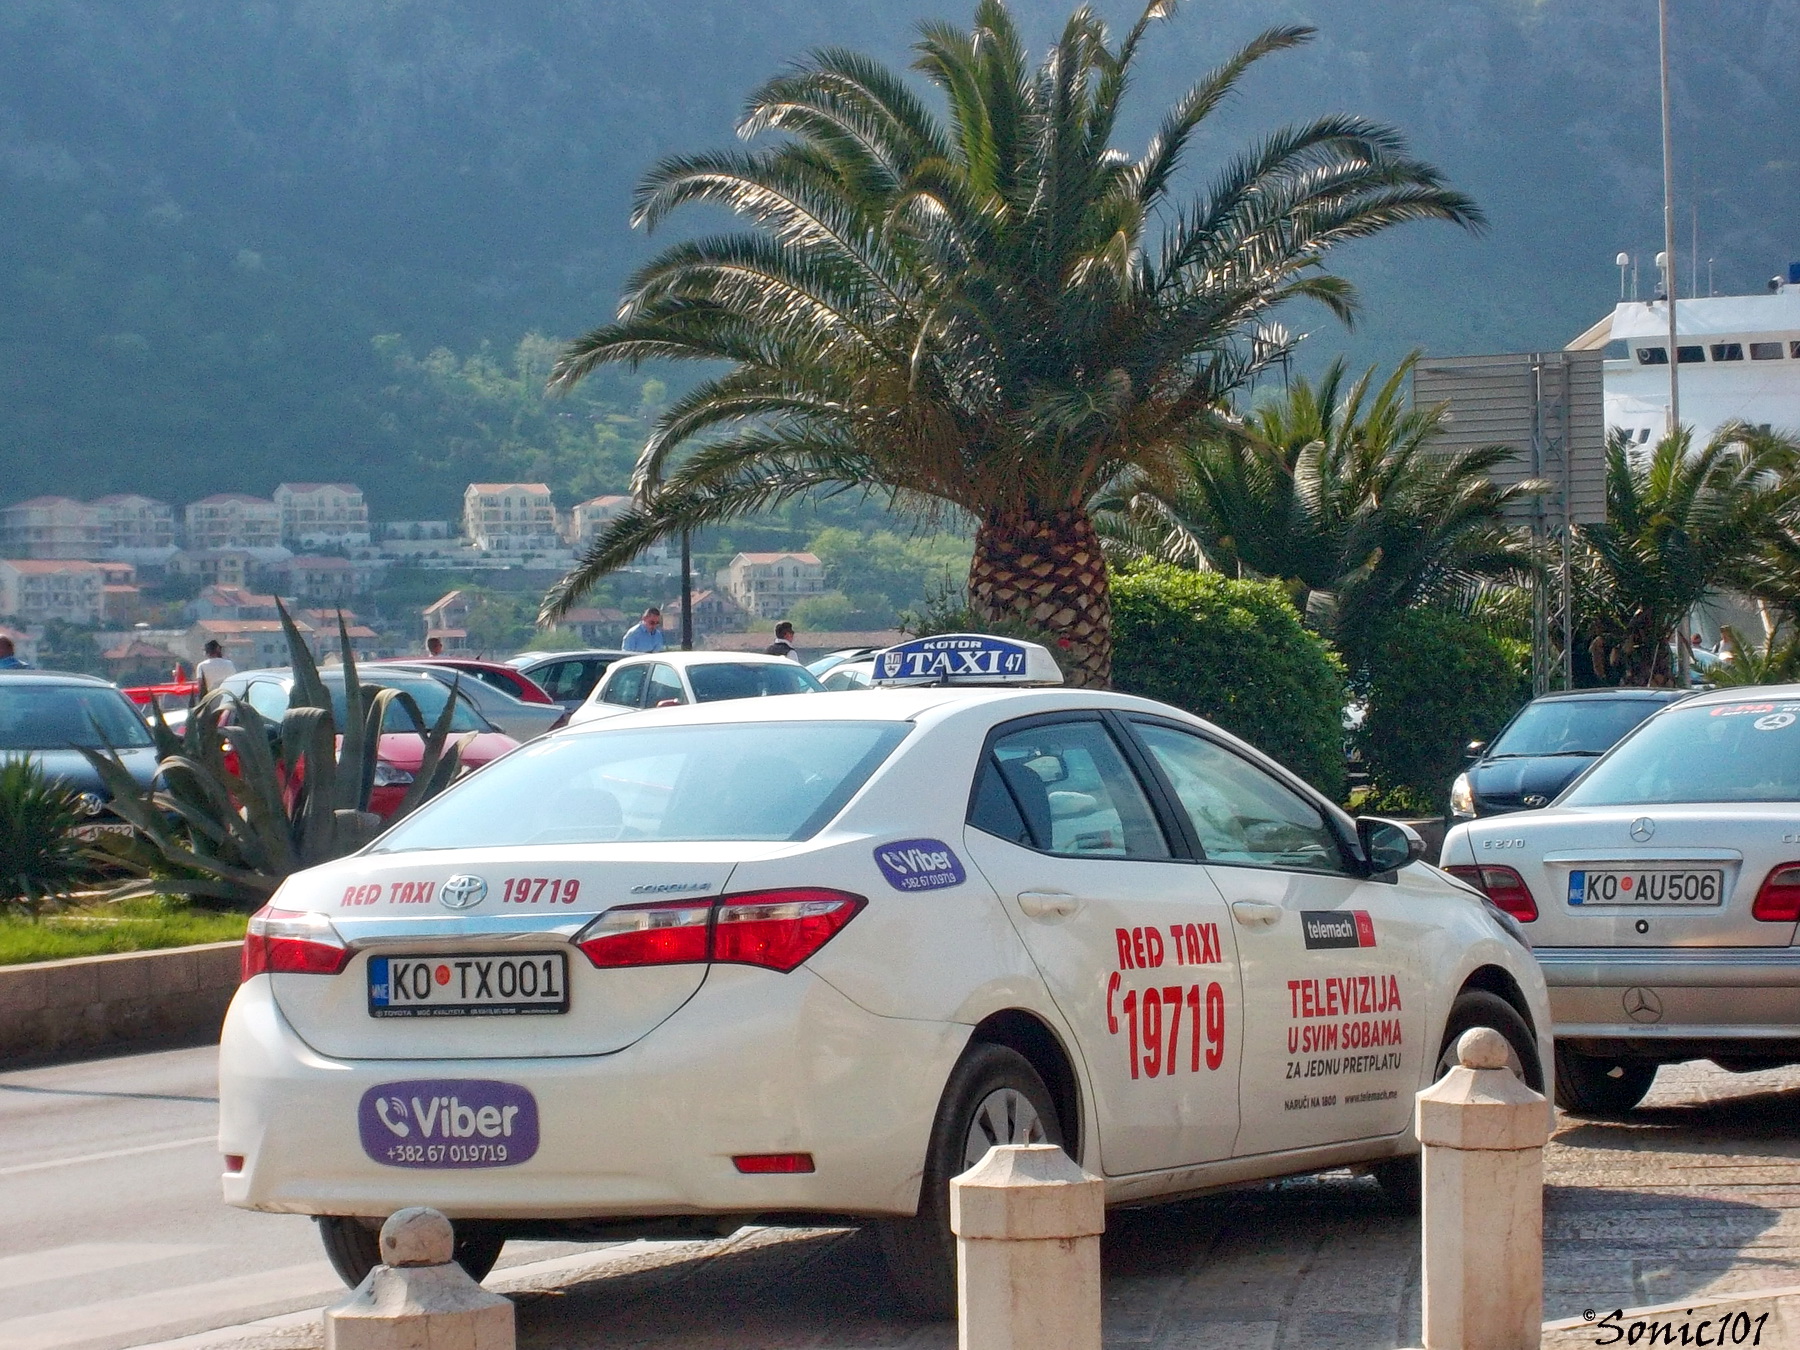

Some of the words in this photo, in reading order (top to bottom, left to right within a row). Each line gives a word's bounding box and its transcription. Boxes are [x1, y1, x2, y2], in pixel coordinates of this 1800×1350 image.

[923, 640, 982, 650] KOTOR
[906, 650, 1003, 675] TAXI
[1004, 654, 1023, 672] 47
[1495, 838, 1526, 849] 270
[898, 848, 952, 873] Viber
[341, 884, 381, 907] RED
[389, 881, 435, 904] TAXI
[502, 877, 580, 904] 19719
[901, 877, 921, 889] +382
[920, 875, 930, 887] 67
[930, 872, 957, 885] 019719
[1586, 874, 1618, 901] KO
[1634, 872, 1716, 900] AU506
[1307, 918, 1353, 939] telemach
[1115, 926, 1165, 970] RED
[1169, 922, 1222, 966] TAXI
[393, 962, 431, 1000] KO
[455, 959, 559, 999] TX001
[1287, 974, 1402, 1018] TELEVIZIJA
[1122, 981, 1225, 1080] 19719
[1288, 1026, 1299, 1054] U
[1301, 1023, 1338, 1053] SVIM
[1341, 1018, 1402, 1050] SOBAMA
[1286, 1061, 1301, 1079] ZA
[1304, 1056, 1341, 1078] JEDNU
[1342, 1052, 1402, 1074] PRETPLATU
[1310, 1096, 1320, 1108] NA
[411, 1096, 519, 1138] Viber
[386, 1145, 425, 1162] +382
[427, 1144, 446, 1162] 67
[450, 1144, 508, 1162] 019719
